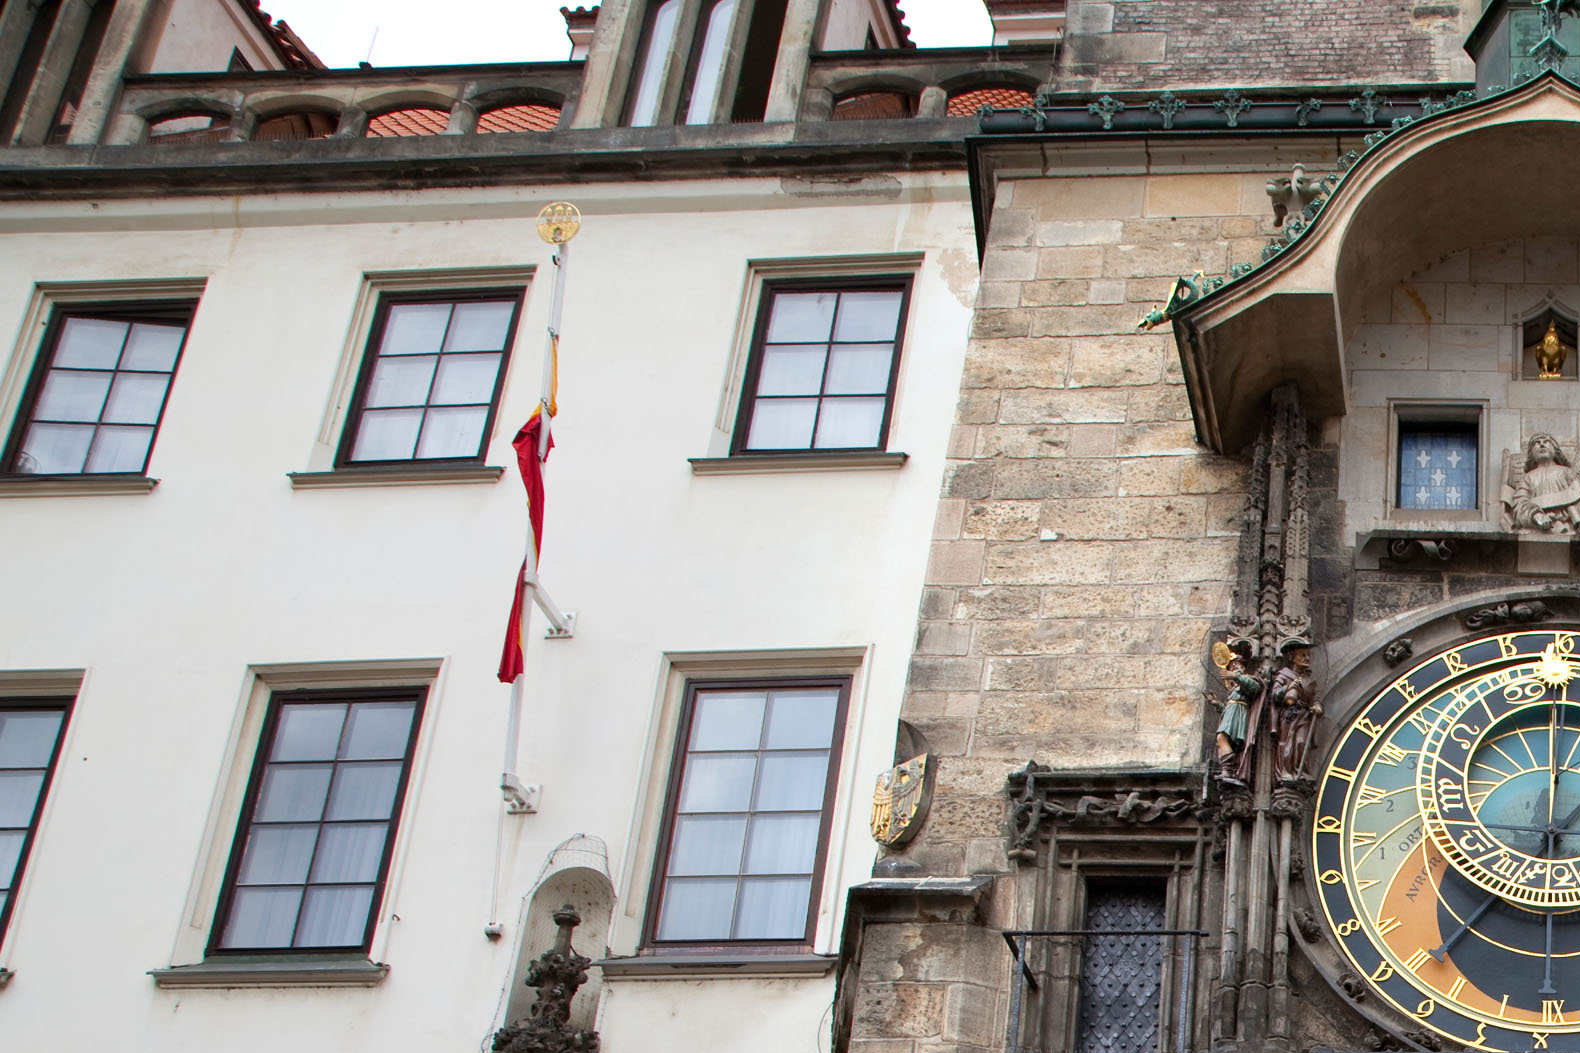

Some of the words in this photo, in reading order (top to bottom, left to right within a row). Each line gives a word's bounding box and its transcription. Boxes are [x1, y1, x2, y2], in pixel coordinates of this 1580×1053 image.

[1385, 799, 1395, 812] 2
[1399, 826, 1424, 853] ORT
[1379, 847, 1386, 860] 1
[1405, 855, 1443, 903] AVROR
